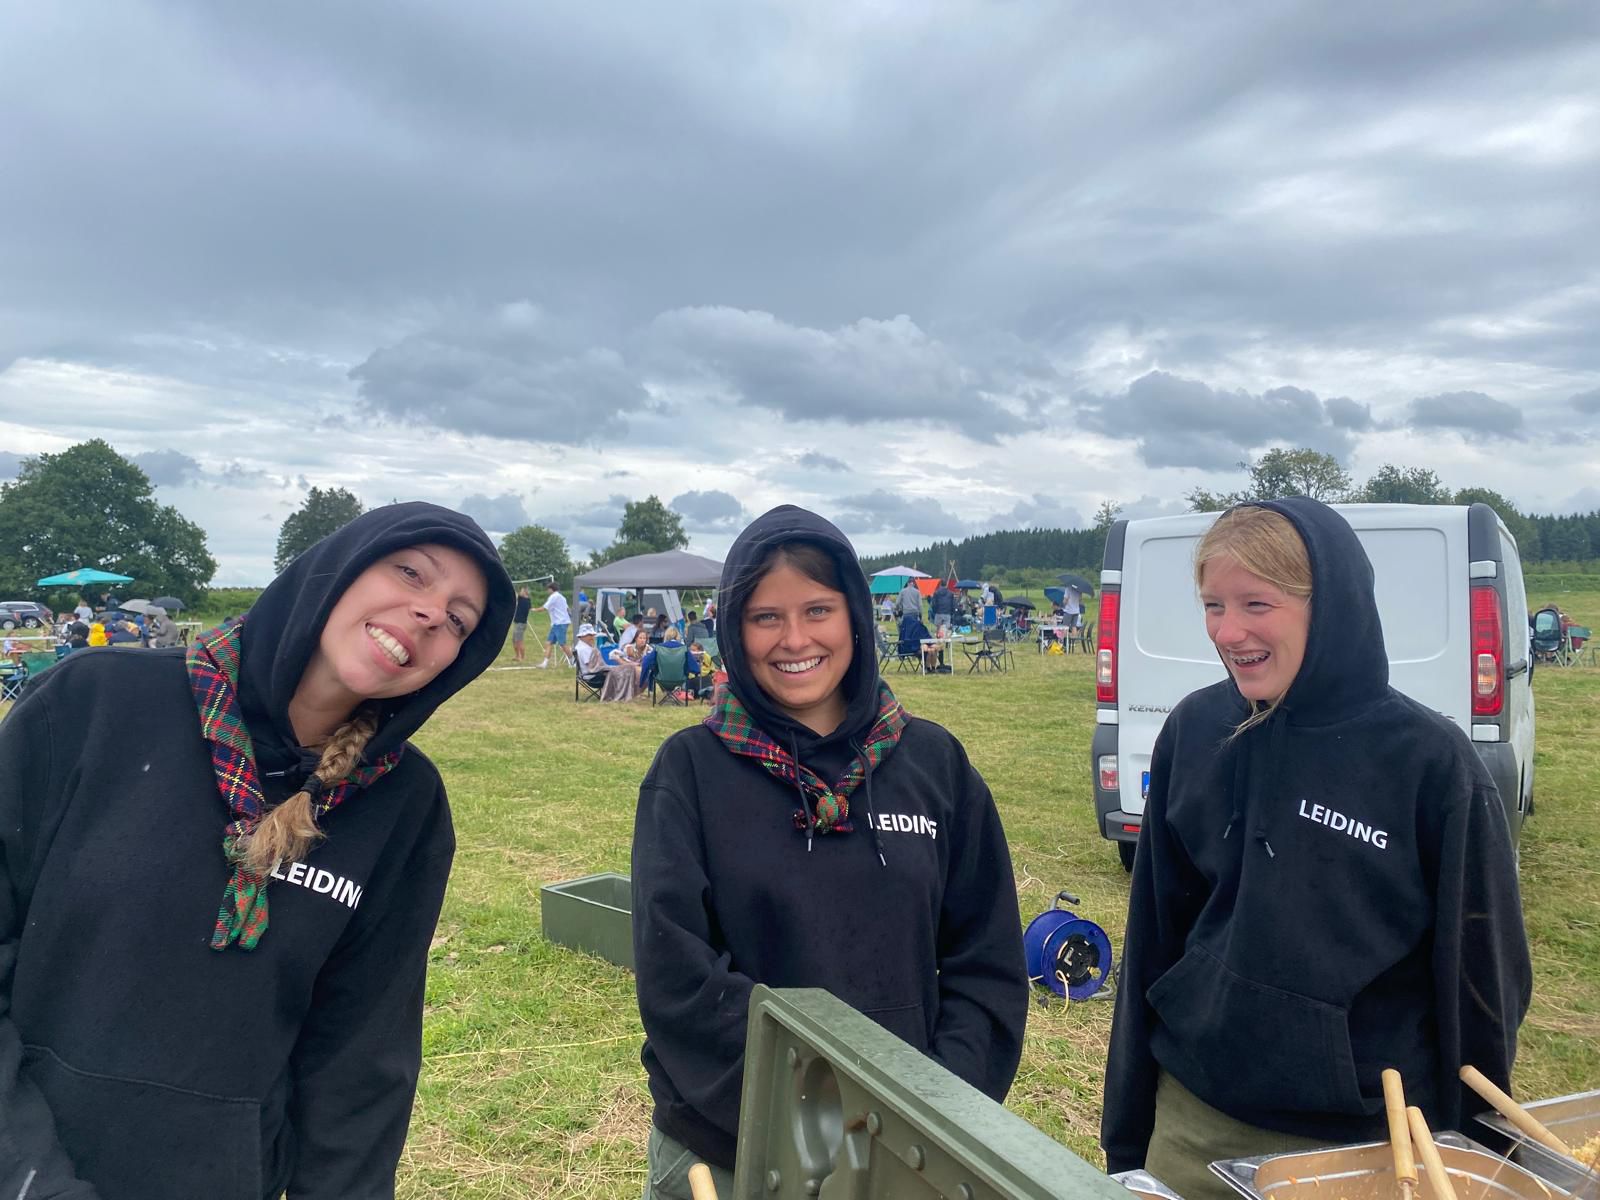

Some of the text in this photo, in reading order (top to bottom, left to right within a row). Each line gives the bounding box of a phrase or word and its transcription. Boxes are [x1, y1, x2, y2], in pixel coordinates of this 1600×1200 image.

[1128, 703, 1171, 713] RENAU
[1299, 799, 1388, 850] LEIDING
[270, 858, 364, 910] LEIDIN
